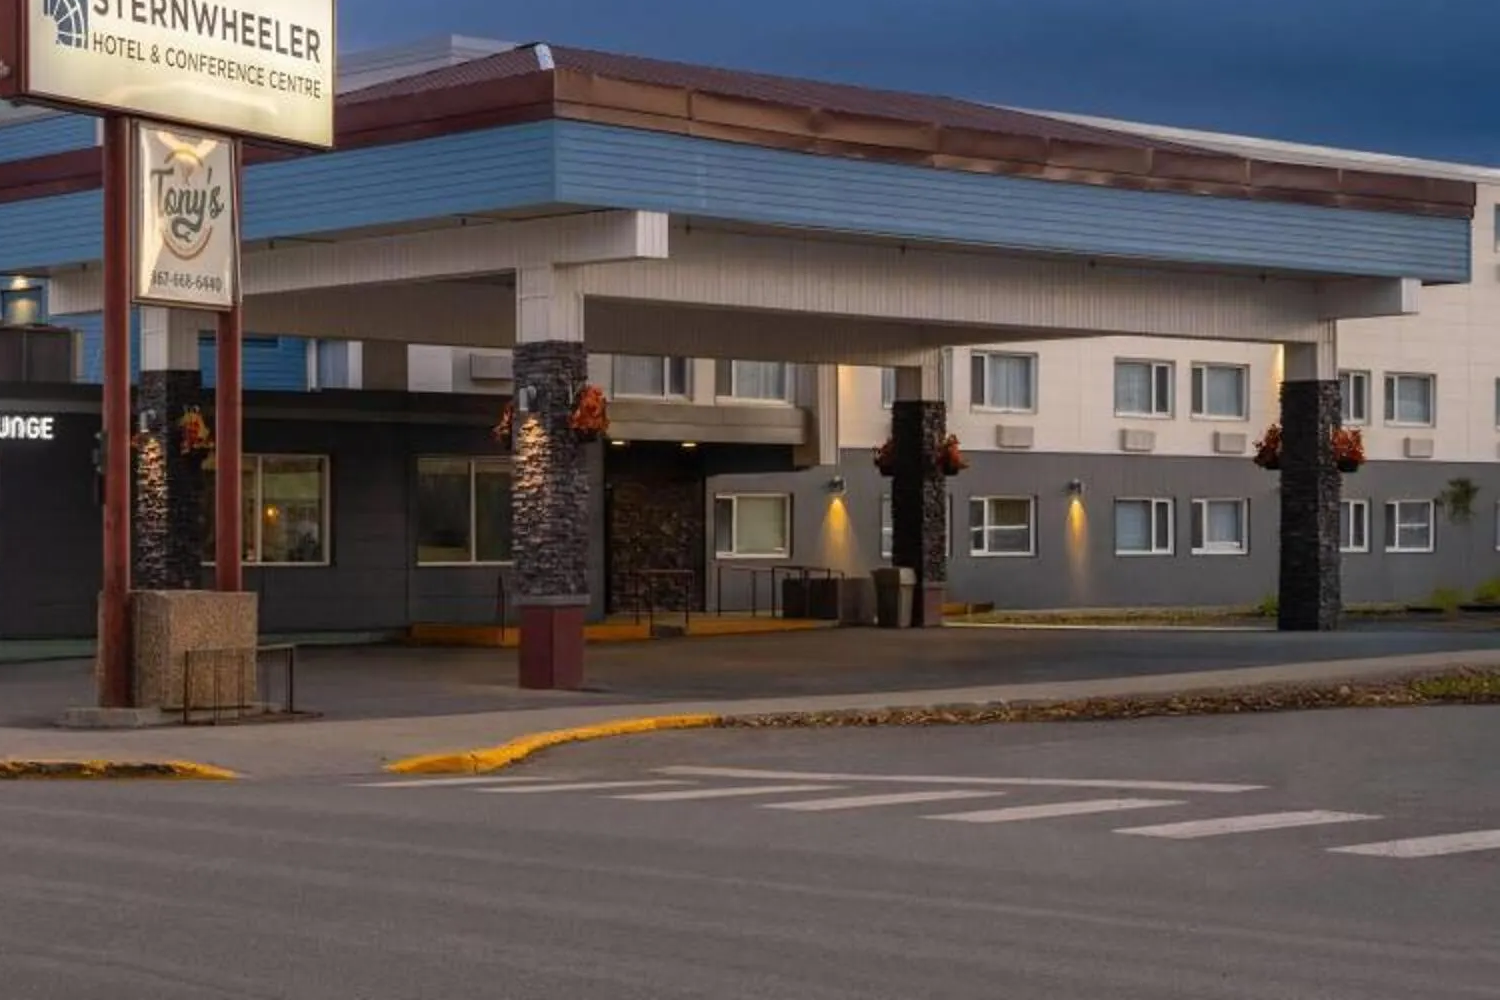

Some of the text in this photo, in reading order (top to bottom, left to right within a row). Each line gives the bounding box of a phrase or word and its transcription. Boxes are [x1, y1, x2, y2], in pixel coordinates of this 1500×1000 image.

[93, 32, 322, 99] HOTEL & CONFERENCE CENTRE
[150, 166, 225, 243] Tony's
